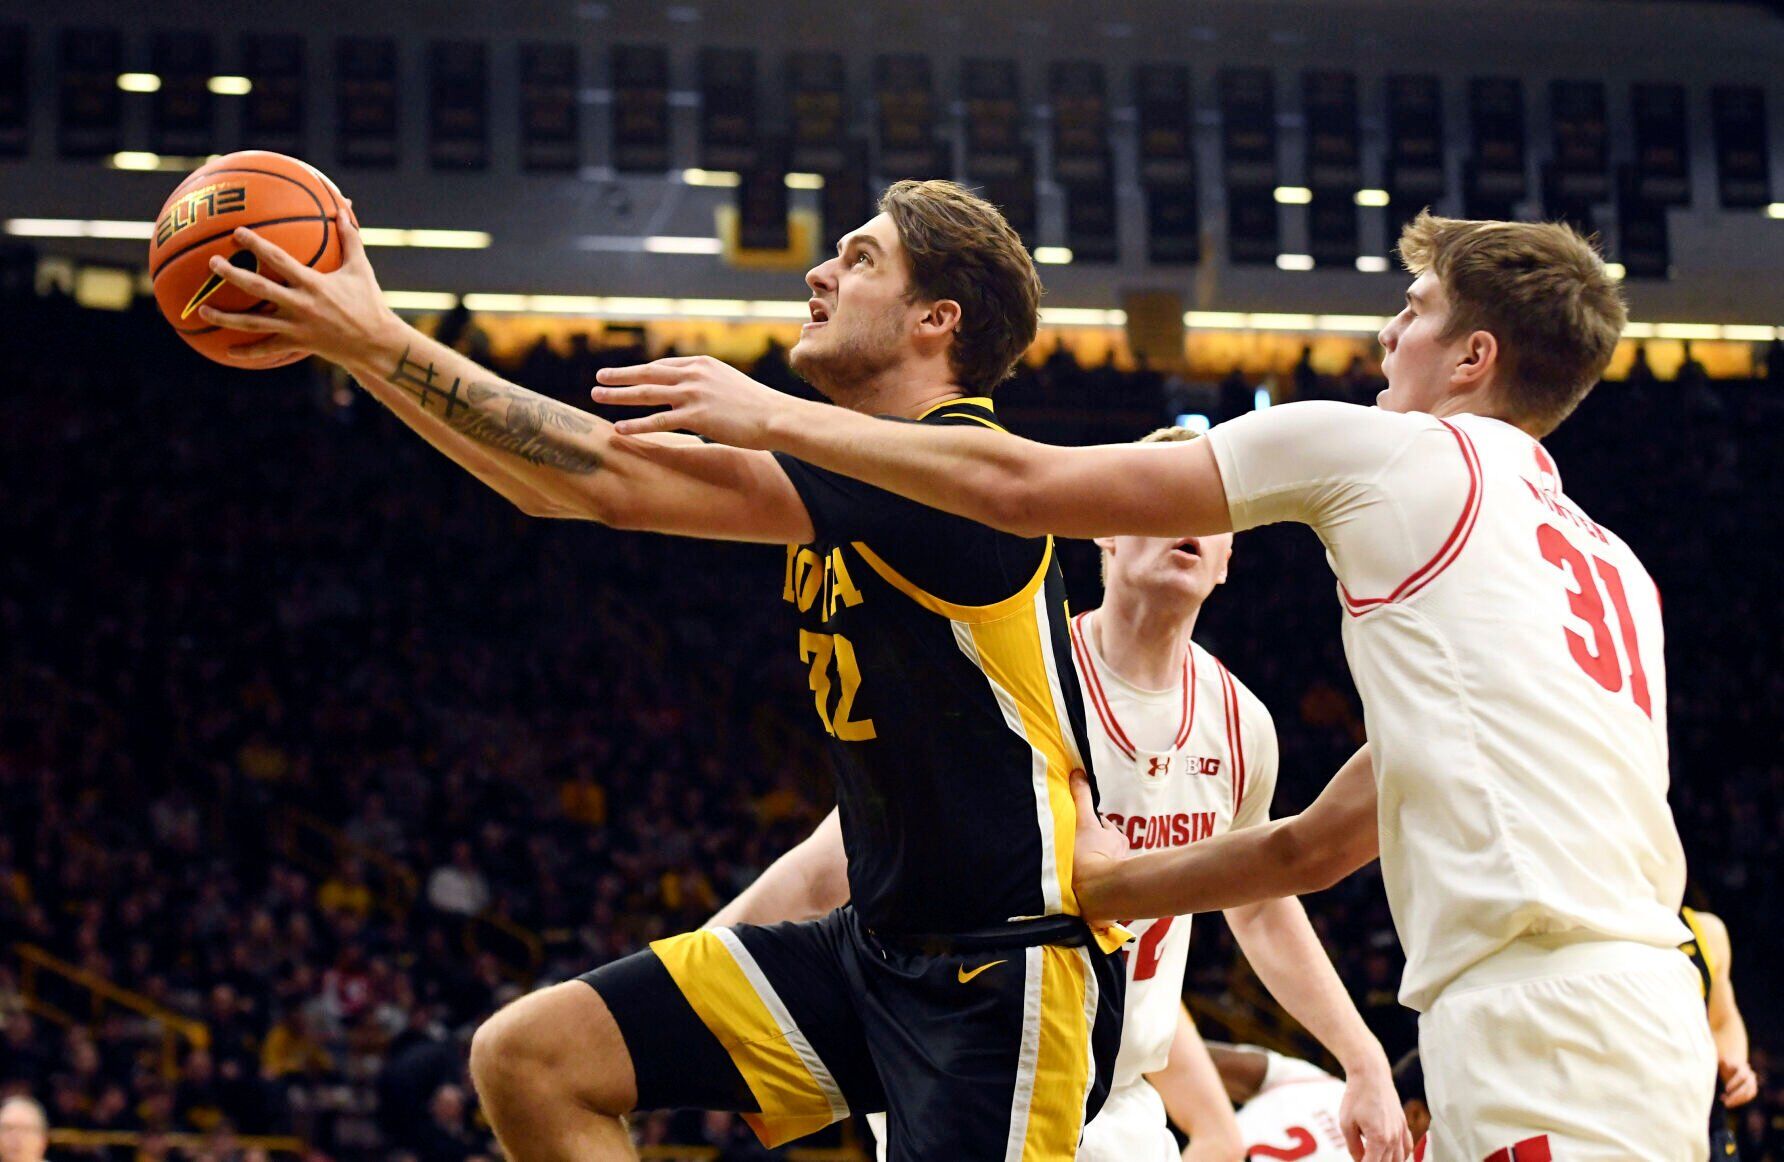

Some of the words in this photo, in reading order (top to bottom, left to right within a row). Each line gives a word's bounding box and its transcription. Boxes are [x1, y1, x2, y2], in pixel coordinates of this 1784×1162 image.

[156, 187, 246, 249] ELITE
[1537, 523, 1653, 720] 31
[1099, 812, 1216, 849] CONSIN
